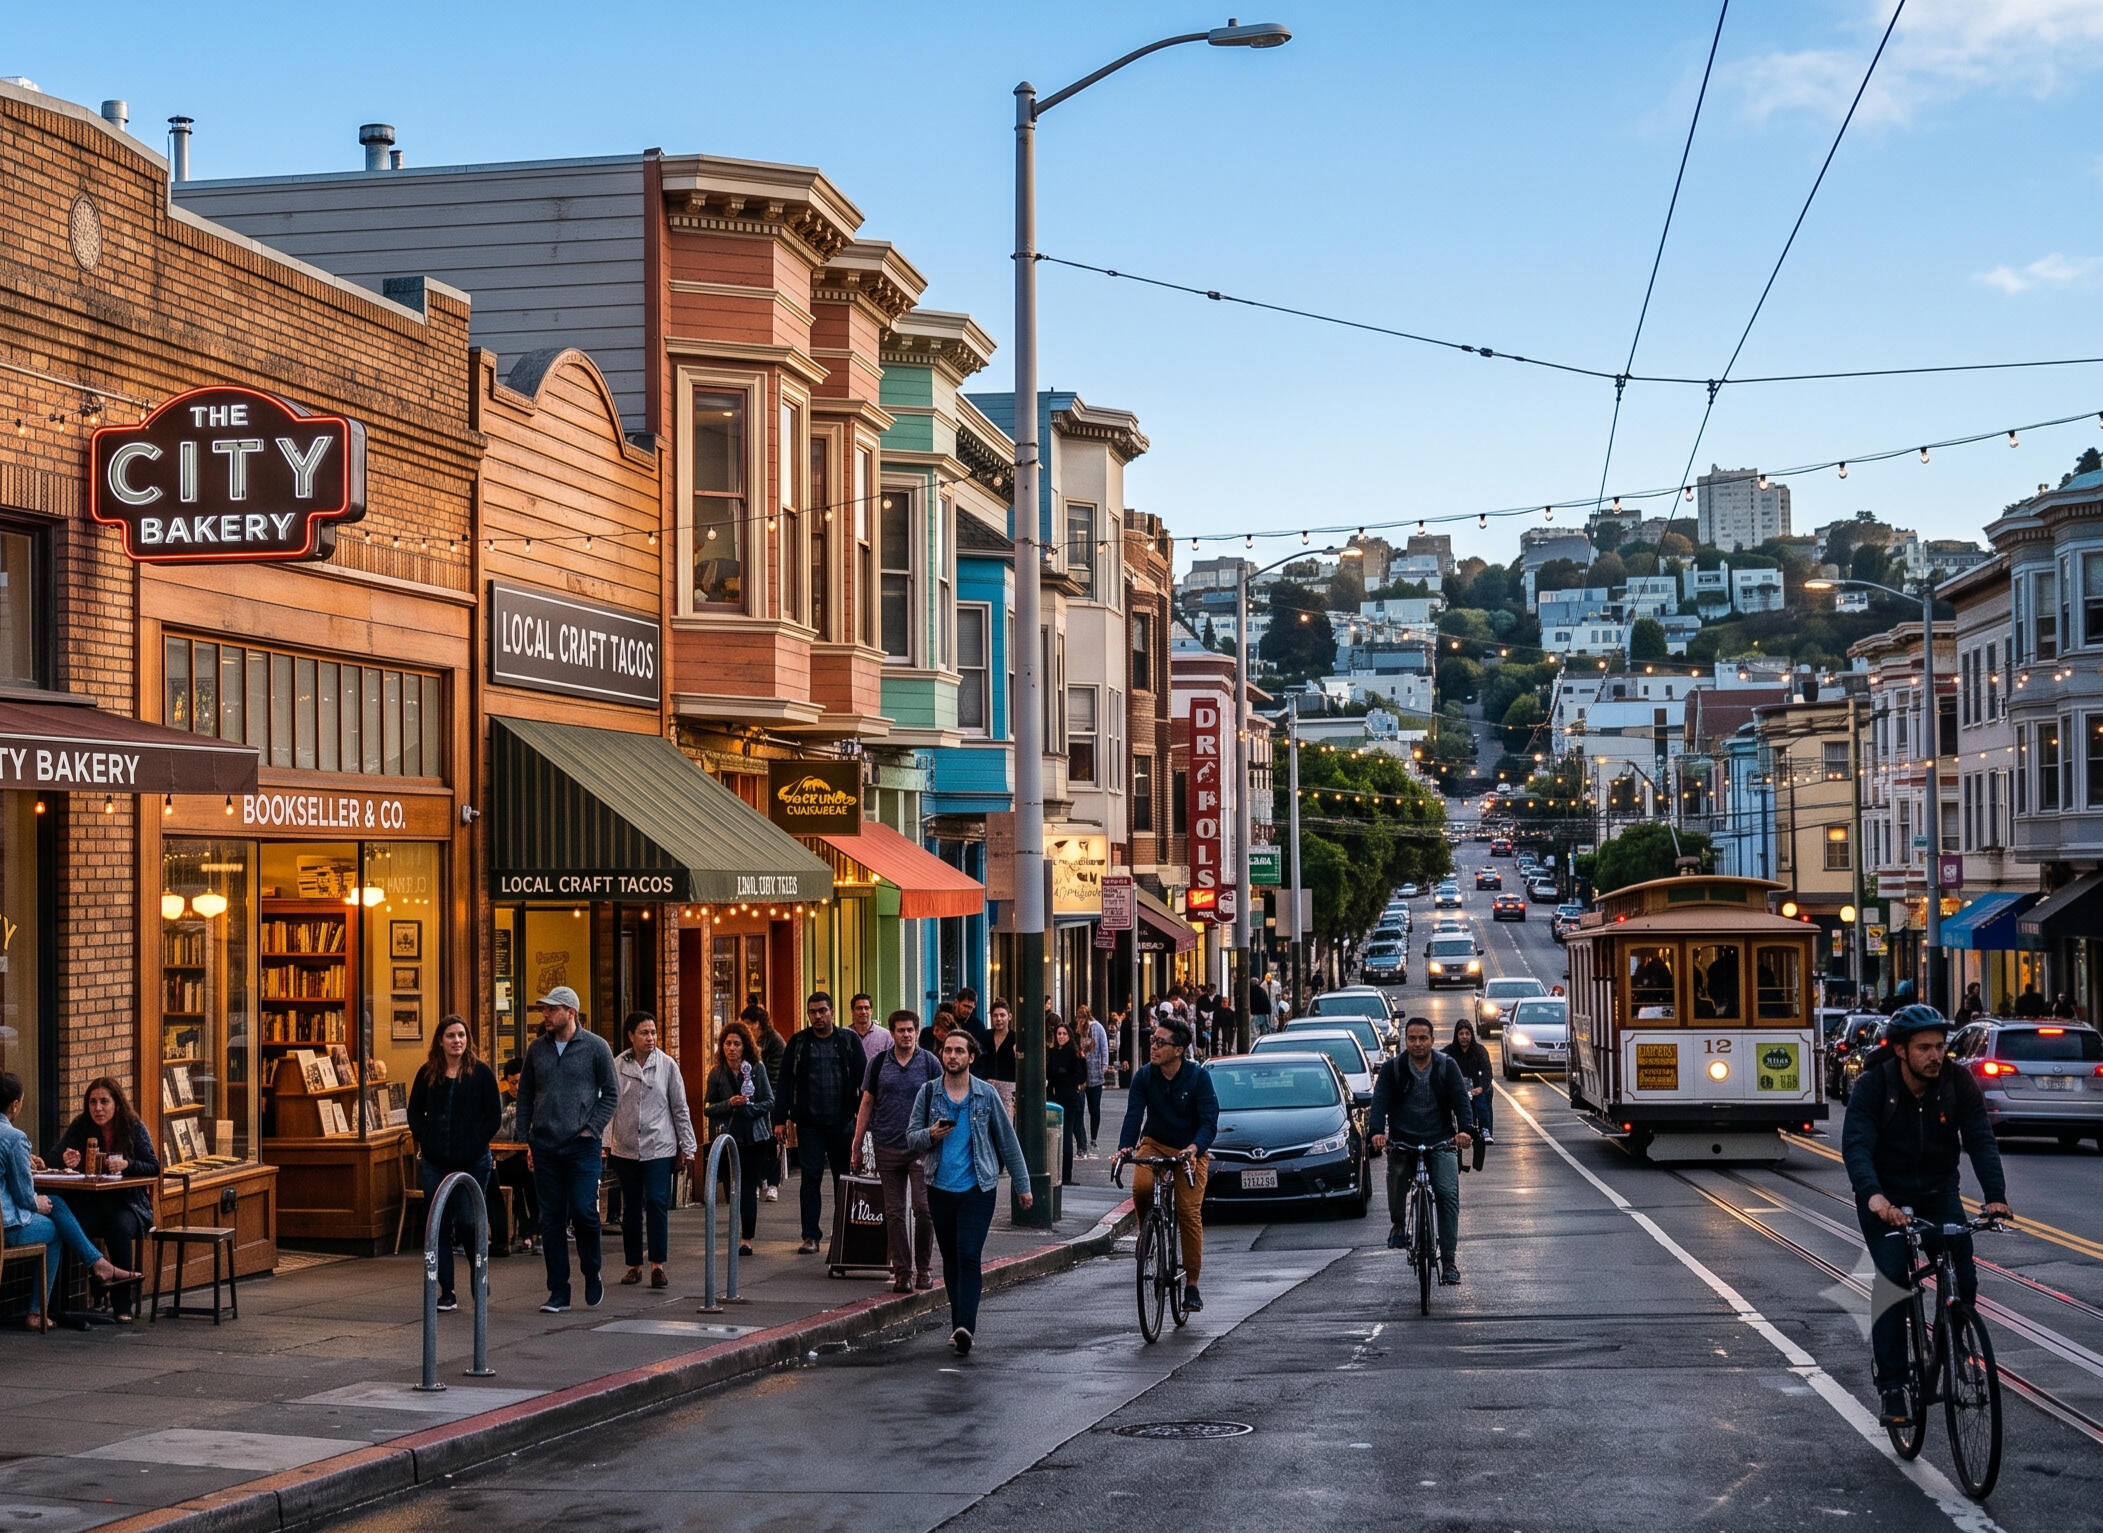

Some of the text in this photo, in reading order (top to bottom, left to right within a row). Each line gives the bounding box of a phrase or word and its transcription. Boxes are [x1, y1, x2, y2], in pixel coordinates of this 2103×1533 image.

[190, 404, 249, 427] THE
[107, 436, 334, 505] CITY
[140, 513, 296, 544] BAKERY
[502, 611, 654, 679] LOCAL CRAFT TACOS
[37, 750, 140, 784] BAKERY
[243, 794, 406, 830] BOOKSELLER & CO.
[501, 875, 674, 894] LOCAL CRAFT TACOS
[1704, 1039, 1732, 1054] 12
